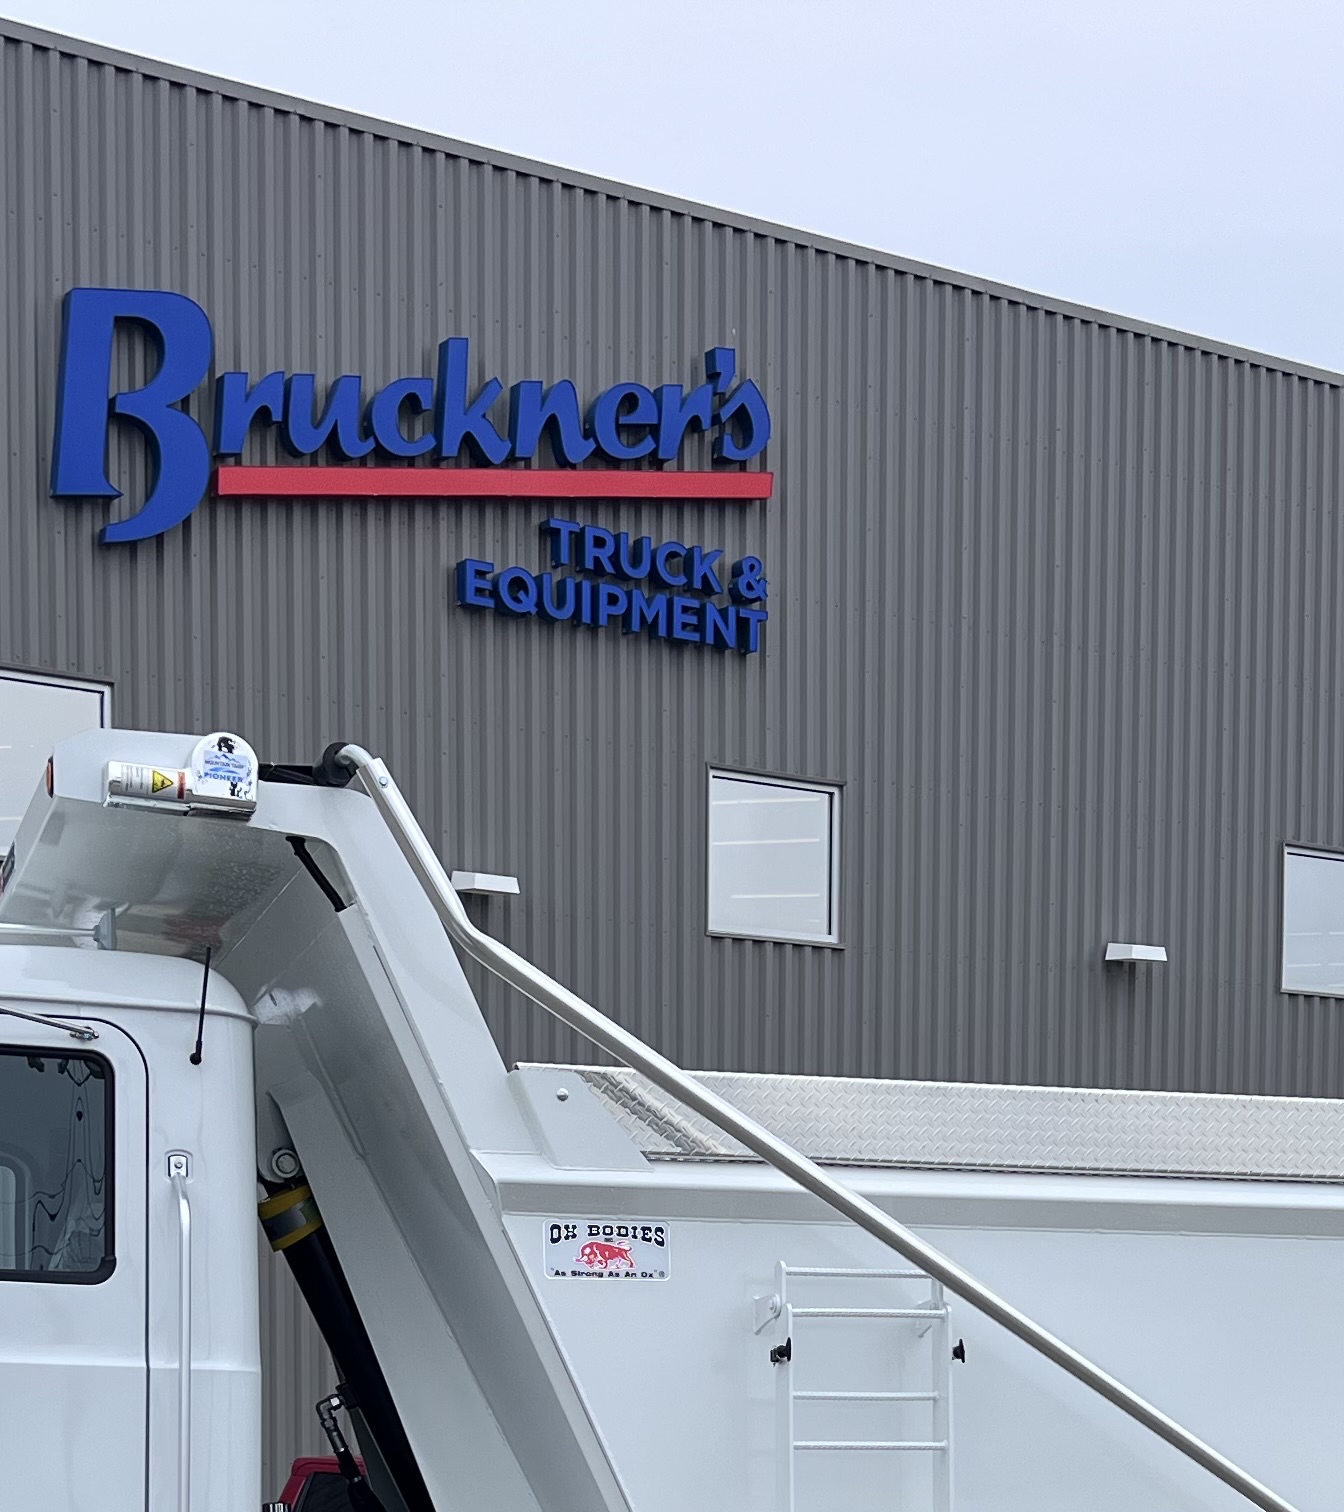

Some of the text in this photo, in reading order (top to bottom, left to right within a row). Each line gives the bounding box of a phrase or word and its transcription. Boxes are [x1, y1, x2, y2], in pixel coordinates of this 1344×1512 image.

[50, 287, 771, 544] Bruckner's
[541, 517, 768, 601] TRUCK &
[457, 558, 768, 654] EQUIPMENT
[203, 772, 244, 783] PIONEER
[549, 1223, 665, 1247] OX BODIES
[571, 1270, 604, 1278] Strong
[608, 1270, 620, 1278] As
[624, 1270, 637, 1278] An
